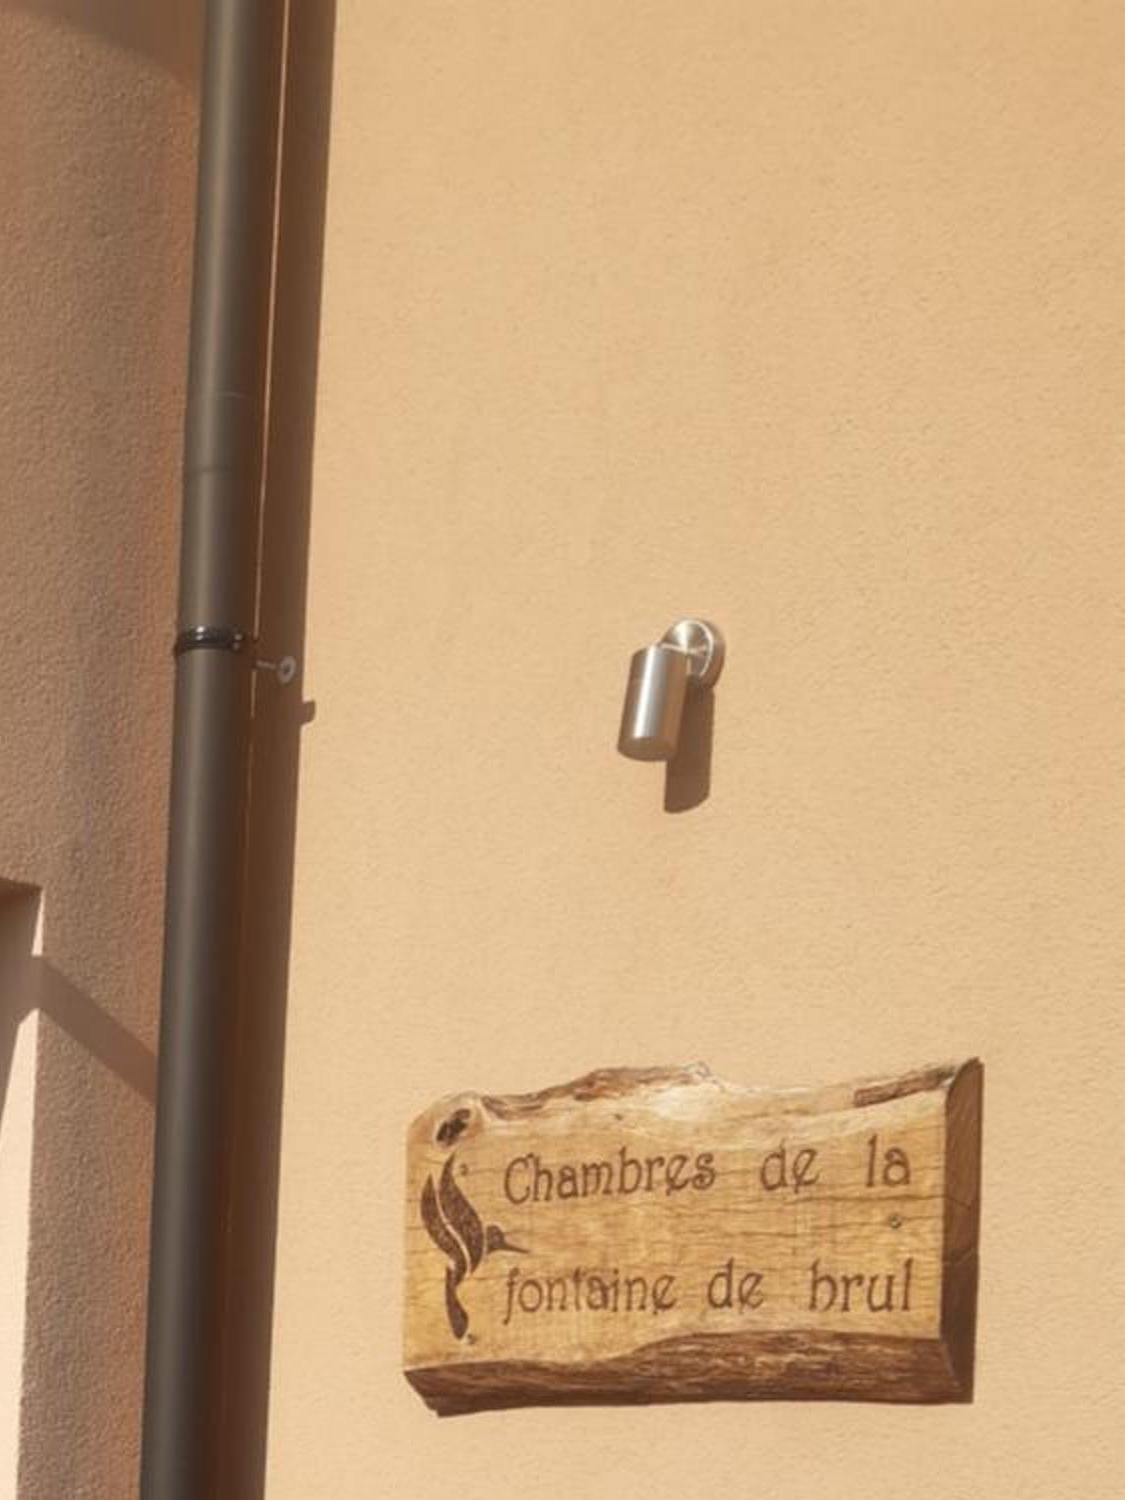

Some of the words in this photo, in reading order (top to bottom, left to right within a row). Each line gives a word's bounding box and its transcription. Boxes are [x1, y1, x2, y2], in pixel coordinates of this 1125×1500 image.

[503, 1147, 717, 1204] Chambres
[760, 1145, 819, 1195] de
[867, 1134, 912, 1188] la
[503, 1266, 676, 1325] fontaine
[706, 1258, 764, 1314] de
[807, 1257, 914, 1314] brul
